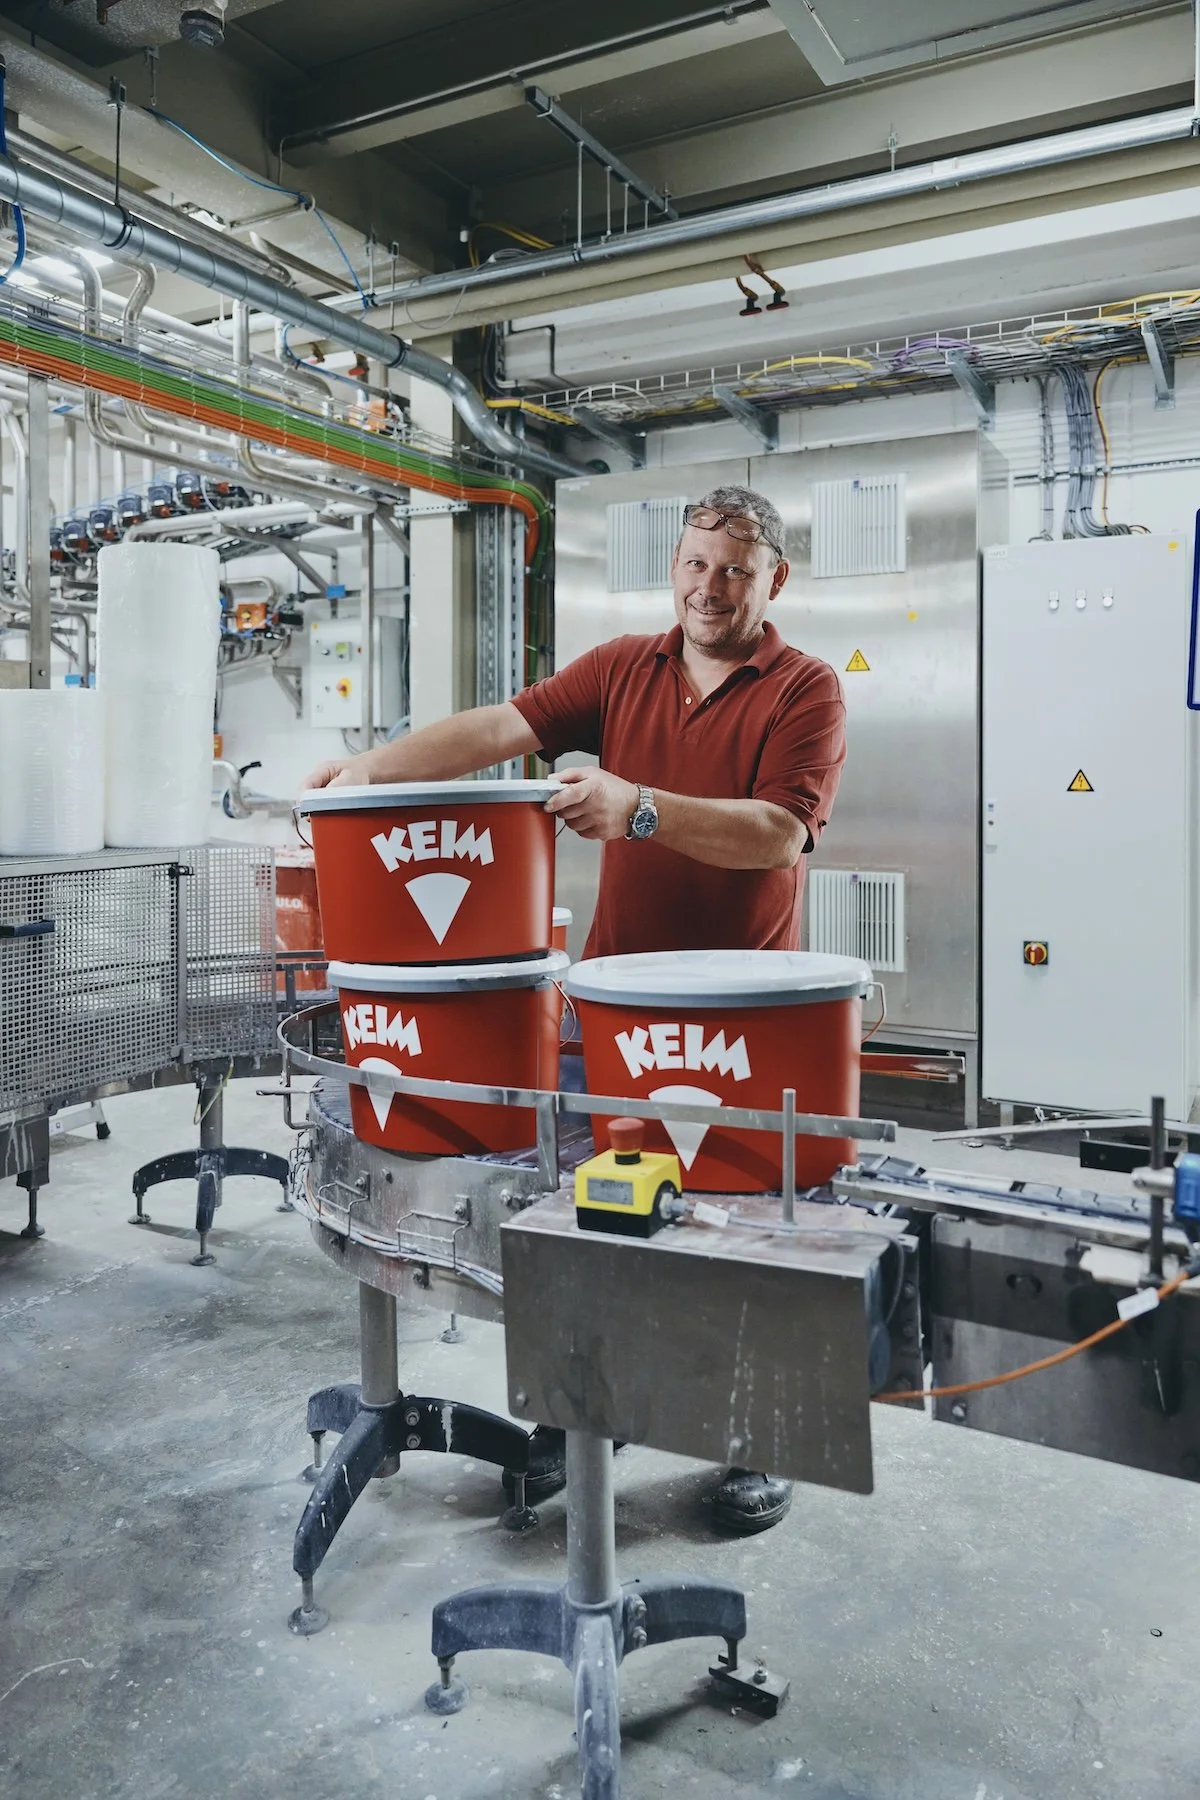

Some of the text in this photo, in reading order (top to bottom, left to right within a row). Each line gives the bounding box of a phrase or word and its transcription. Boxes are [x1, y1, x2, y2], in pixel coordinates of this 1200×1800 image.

[371, 820, 495, 873] KEIM
[343, 1003, 422, 1057] KEIM
[614, 1023, 752, 1082] KEIM
